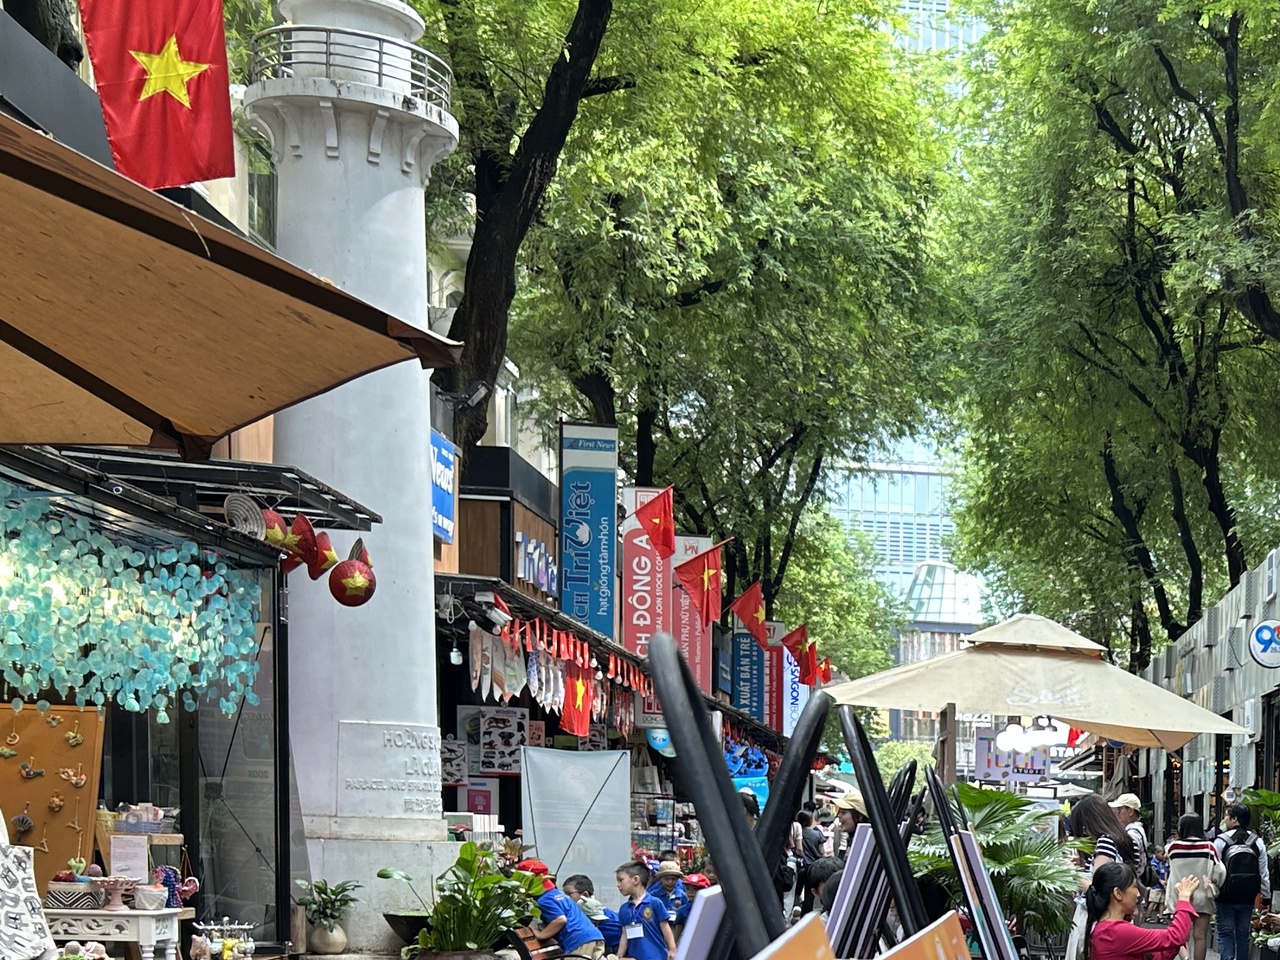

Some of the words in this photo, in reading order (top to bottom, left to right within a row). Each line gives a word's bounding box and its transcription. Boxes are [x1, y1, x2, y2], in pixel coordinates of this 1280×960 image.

[627, 556, 651, 627] ĐÔNG
[736, 636, 751, 656] TRẺ
[736, 658, 750, 679] BẢN
[736, 681, 750, 705] XUẤT
[790, 668, 800, 706] SAIGON
[344, 778, 387, 791] PARACEL
